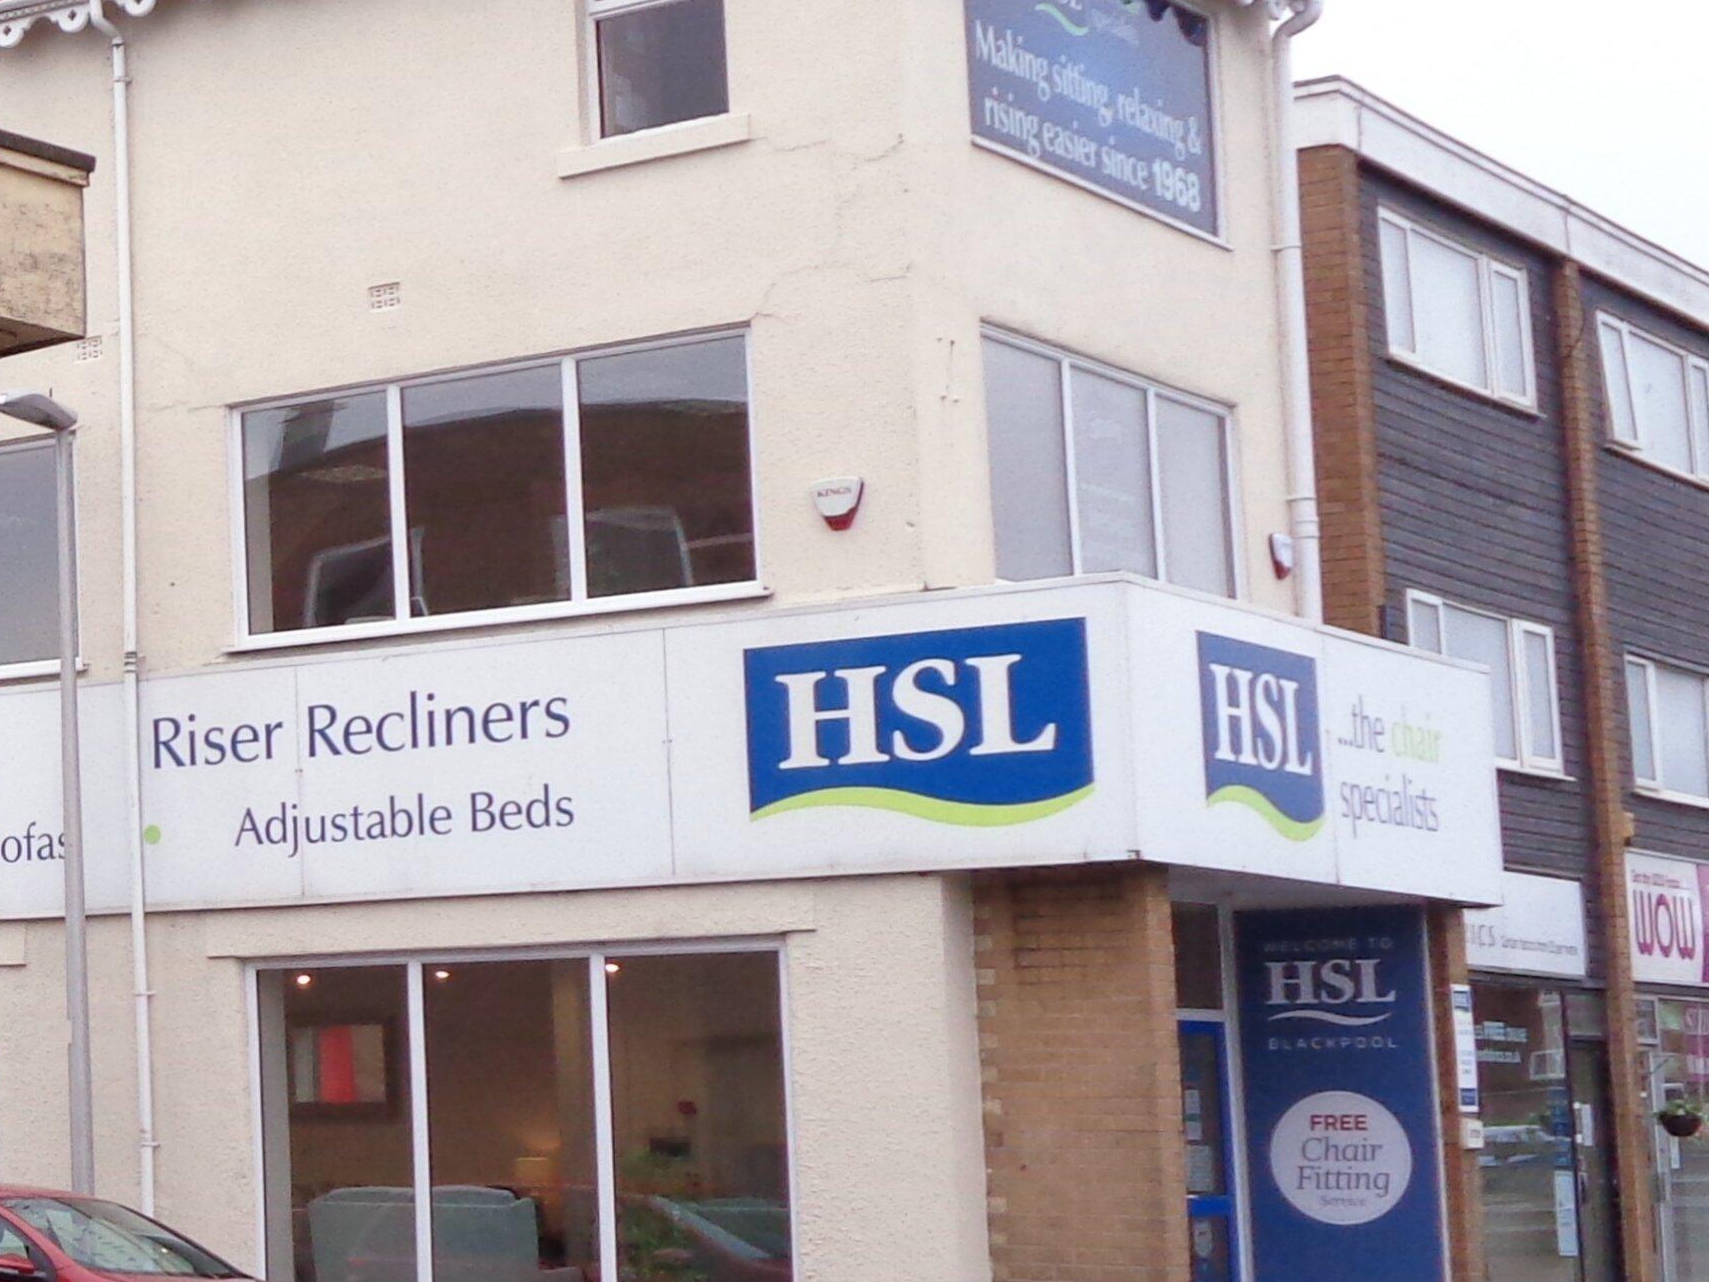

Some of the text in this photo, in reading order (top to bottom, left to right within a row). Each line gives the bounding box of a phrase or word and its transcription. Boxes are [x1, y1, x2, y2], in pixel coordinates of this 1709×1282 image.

[975, 19, 1049, 101] Making
[1118, 87, 1186, 160] relaxing
[1187, 117, 1202, 155] &
[984, 86, 1201, 212] rising easier since 1968
[152, 690, 570, 769] Riser Recliners
[775, 653, 1057, 769] HSL
[1209, 663, 1312, 776] HSL
[1391, 704, 1442, 763] chair
[234, 784, 575, 858] Adjustable Beds
[1340, 774, 1439, 839] specialists
[1264, 937, 1394, 952] WELCOME TO
[1632, 889, 1696, 960] WOW
[1264, 958, 1397, 1005] HSL
[1268, 1036, 1397, 1050] BLACKPOOL
[1301, 1137, 1383, 1162] Chair
[1310, 1115, 1369, 1131] FREE
[1296, 1166, 1391, 1197] Fitting
